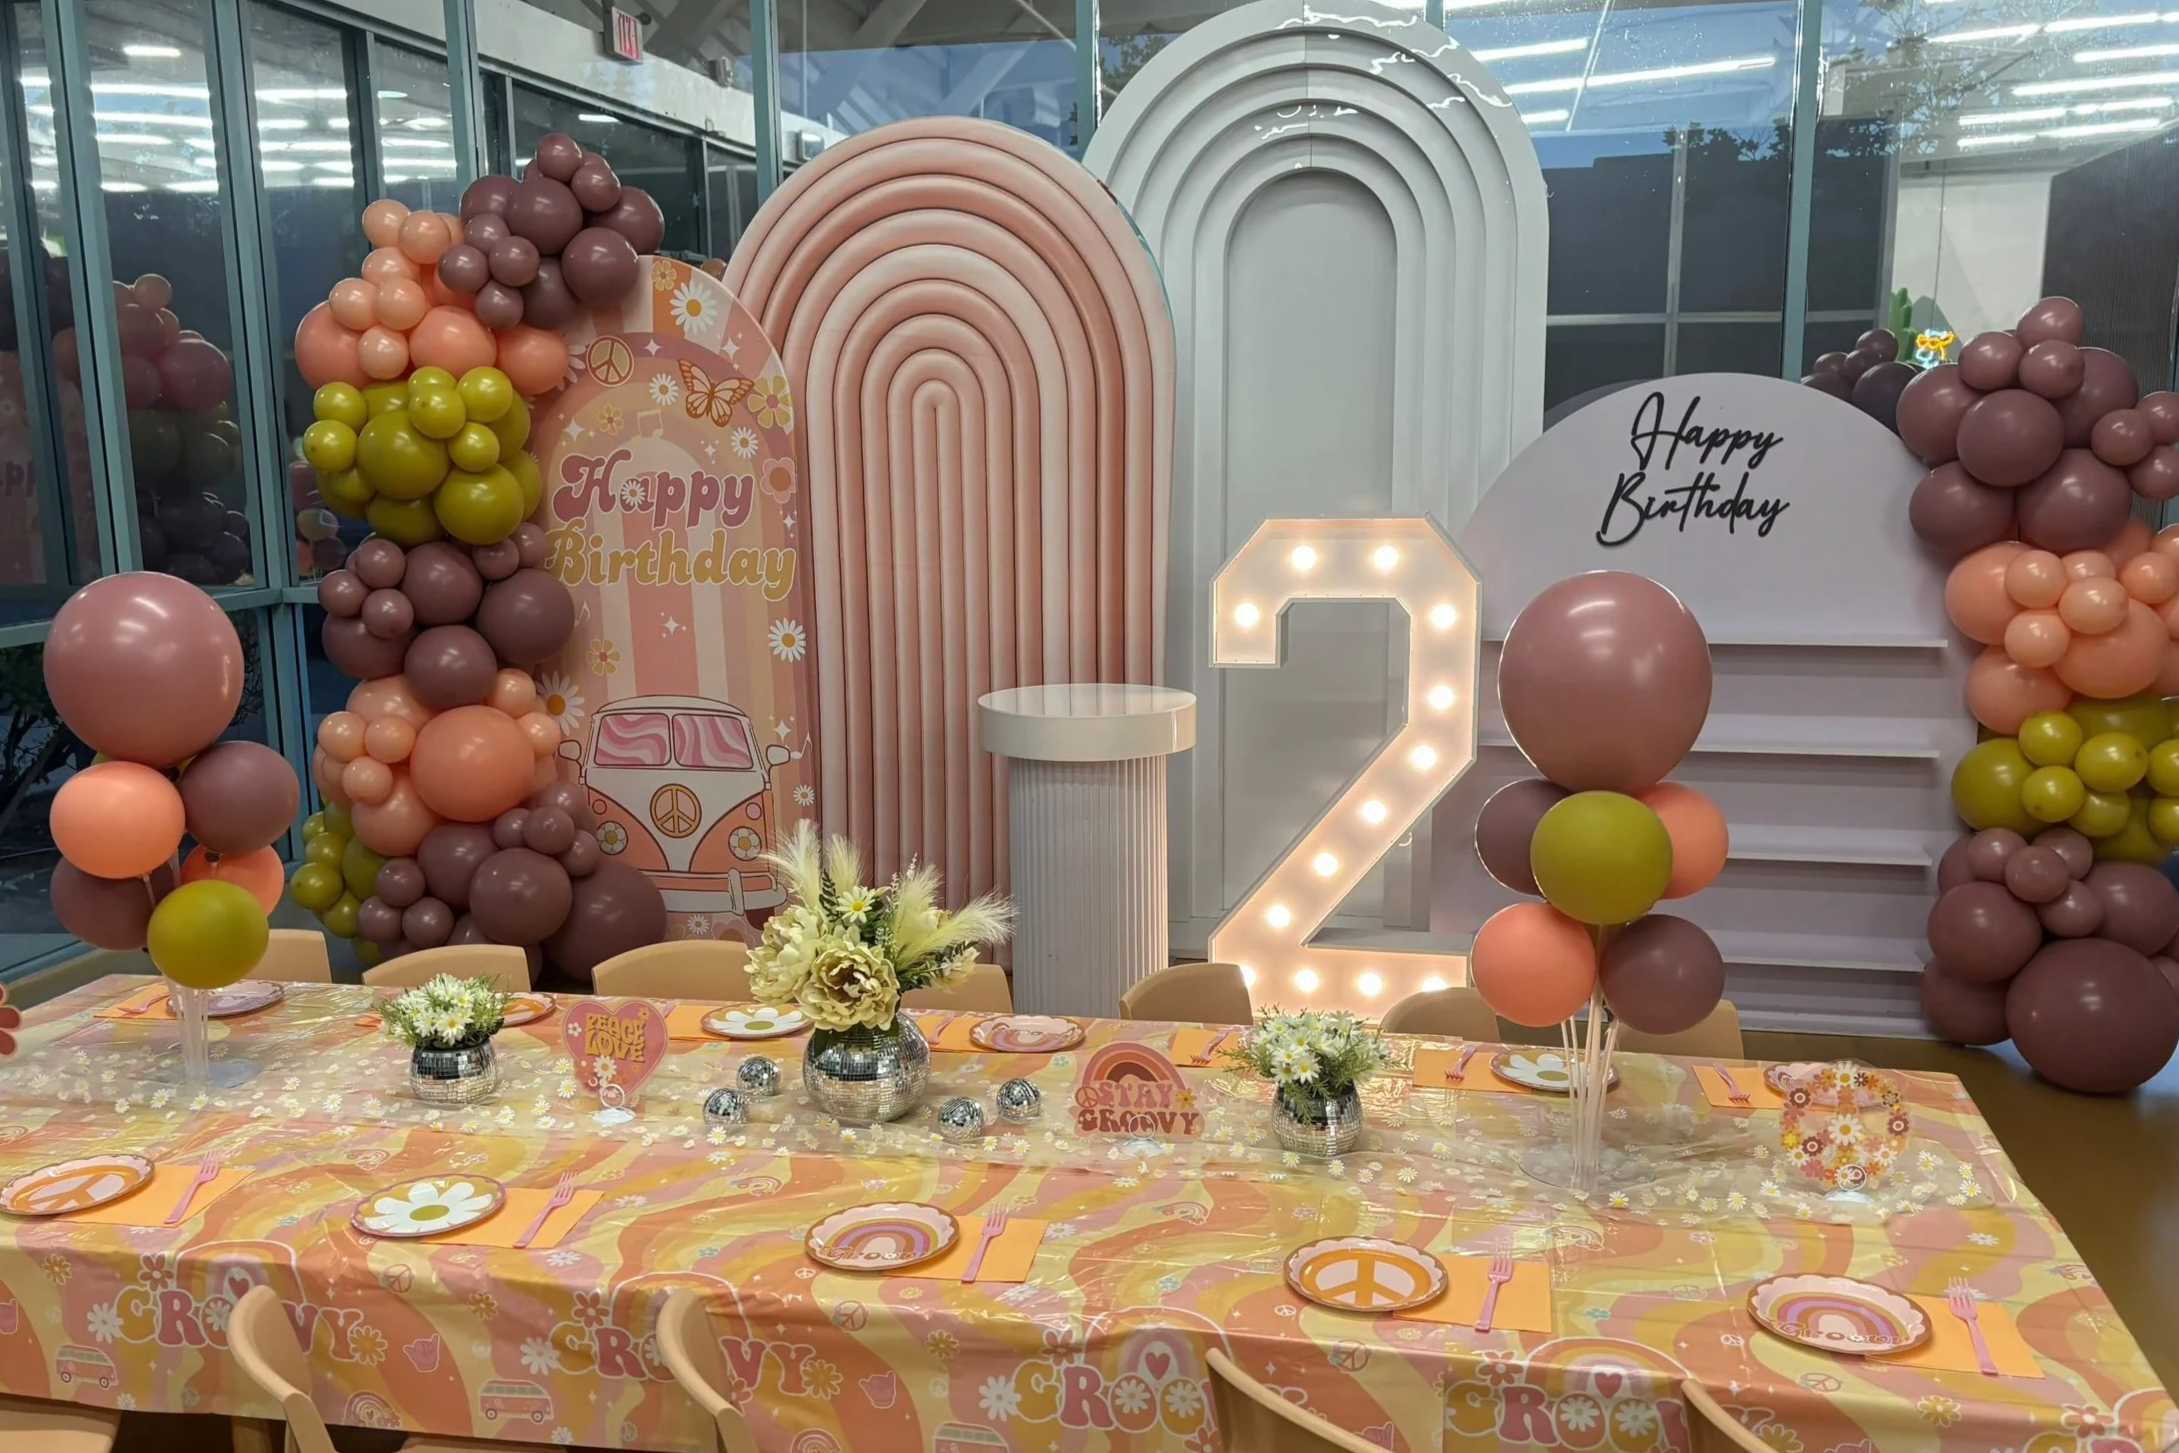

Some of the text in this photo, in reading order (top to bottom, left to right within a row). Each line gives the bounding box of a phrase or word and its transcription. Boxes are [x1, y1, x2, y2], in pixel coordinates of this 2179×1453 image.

[1630, 391, 1784, 470] Happy
[552, 447, 754, 530] Happy
[1596, 471, 1790, 547] Birthday
[544, 517, 797, 602] Birthday
[1209, 511, 1483, 1026] 2
[585, 1029, 646, 1063] LOVE
[586, 1012, 646, 1047] PEACE
[1077, 1107, 1200, 1136] GROOVY
[1097, 1081, 1175, 1109] STAY
